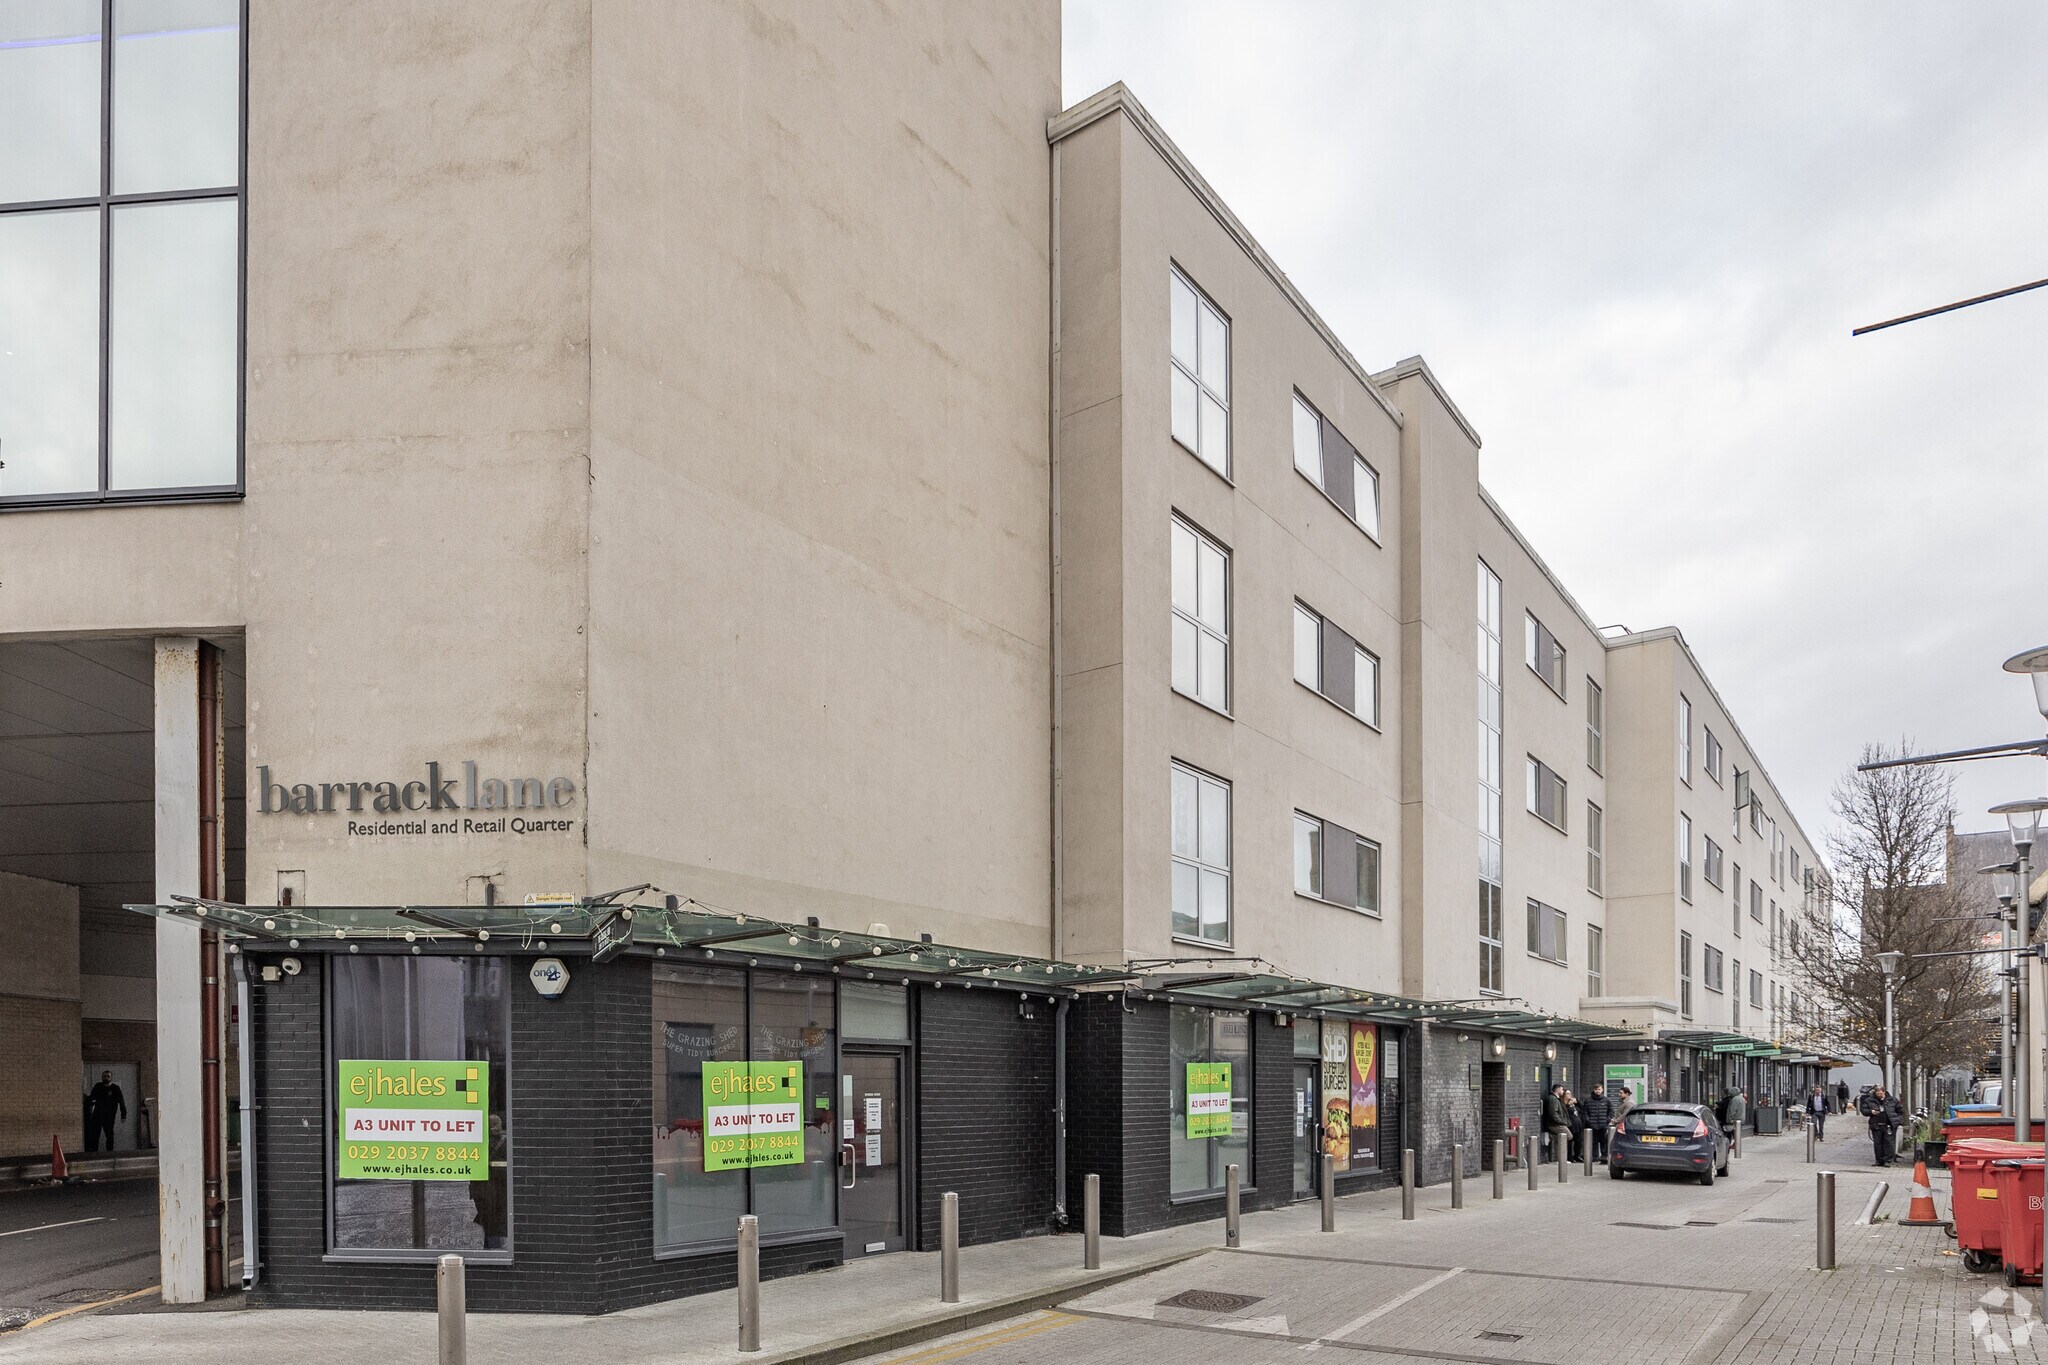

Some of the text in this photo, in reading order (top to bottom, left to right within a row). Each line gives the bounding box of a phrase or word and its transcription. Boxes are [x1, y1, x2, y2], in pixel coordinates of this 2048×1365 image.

[256, 760, 575, 814] barracklane
[348, 817, 574, 836] Residential and Retail Quarter
[660, 1021, 738, 1047] THE GRAZING SHED
[760, 1024, 828, 1048] THE GRAZING SHED
[662, 1038, 684, 1055] SUPER
[687, 1048, 704, 1057] TIDY
[784, 1049, 798, 1058] TIDY
[1323, 1034, 1348, 1063] SHED
[1323, 1062, 1337, 1074] SUPER
[349, 1067, 447, 1104] ejhales
[710, 1067, 776, 1102] ejhaes
[1189, 1067, 1220, 1090] ejhales
[1323, 1074, 1348, 1090] BURGERS
[1199, 1100, 1211, 1108] UNIT
[1219, 1098, 1228, 1106] LET
[353, 1119, 475, 1132] A3 UNIT TO LET
[714, 1116, 729, 1127] A3
[758, 1114, 773, 1124] TO
[776, 1112, 795, 1123] LET
[1190, 1117, 1200, 1127] 029
[348, 1145, 480, 1162] 029 2037 8844
[710, 1139, 735, 1154] 029
[769, 1135, 799, 1149] 8844
[362, 1164, 472, 1176] www.ejhales.co.uk
